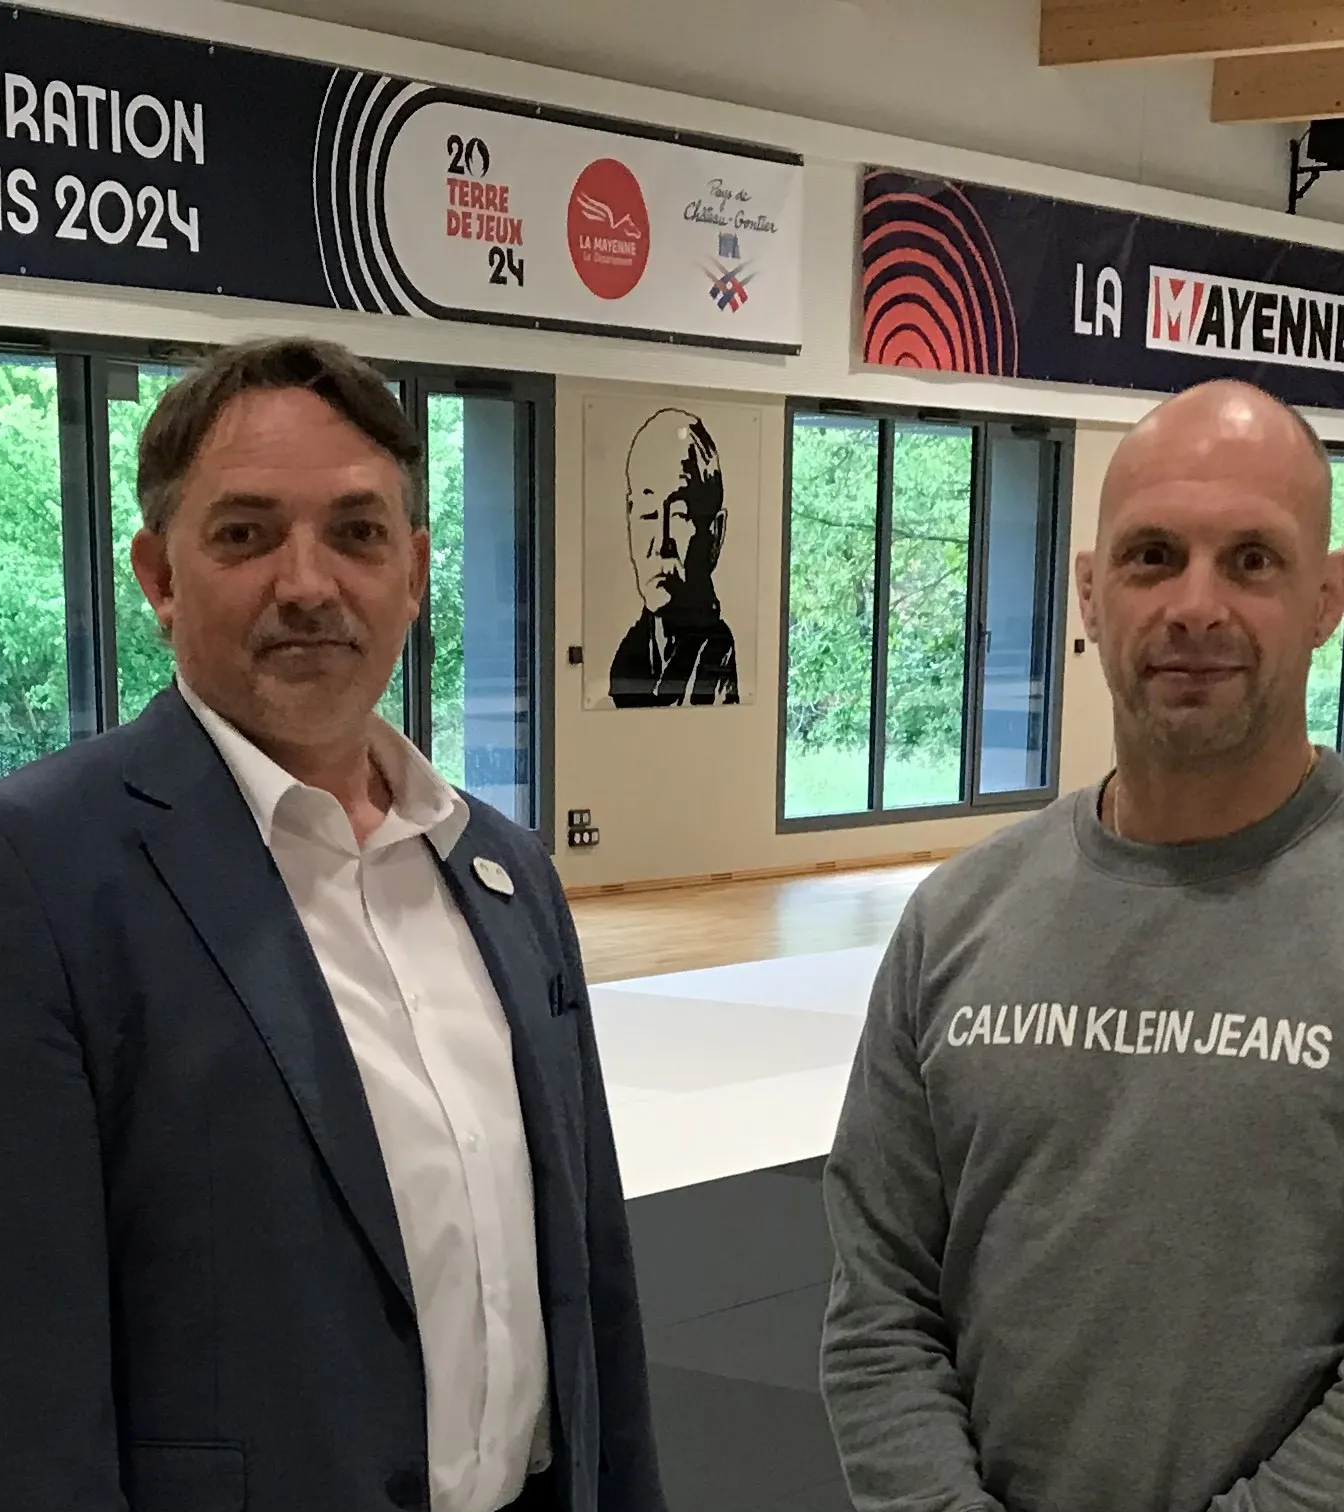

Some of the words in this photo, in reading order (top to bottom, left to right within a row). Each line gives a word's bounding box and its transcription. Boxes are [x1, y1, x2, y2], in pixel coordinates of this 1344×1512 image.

[446, 133, 491, 178] 20
[55, 173, 200, 253] 2024
[446, 177, 510, 213] TERRE
[446, 209, 473, 239] DE
[476, 214, 524, 246] JEUX
[579, 235, 592, 249] LA
[593, 237, 636, 256] MAYENNE
[488, 246, 525, 287] 24
[1073, 262, 1122, 338] LA
[947, 1003, 1078, 1048] CALVIN
[1083, 1006, 1195, 1055] KLEIN
[1194, 1011, 1333, 1071] JEANS
